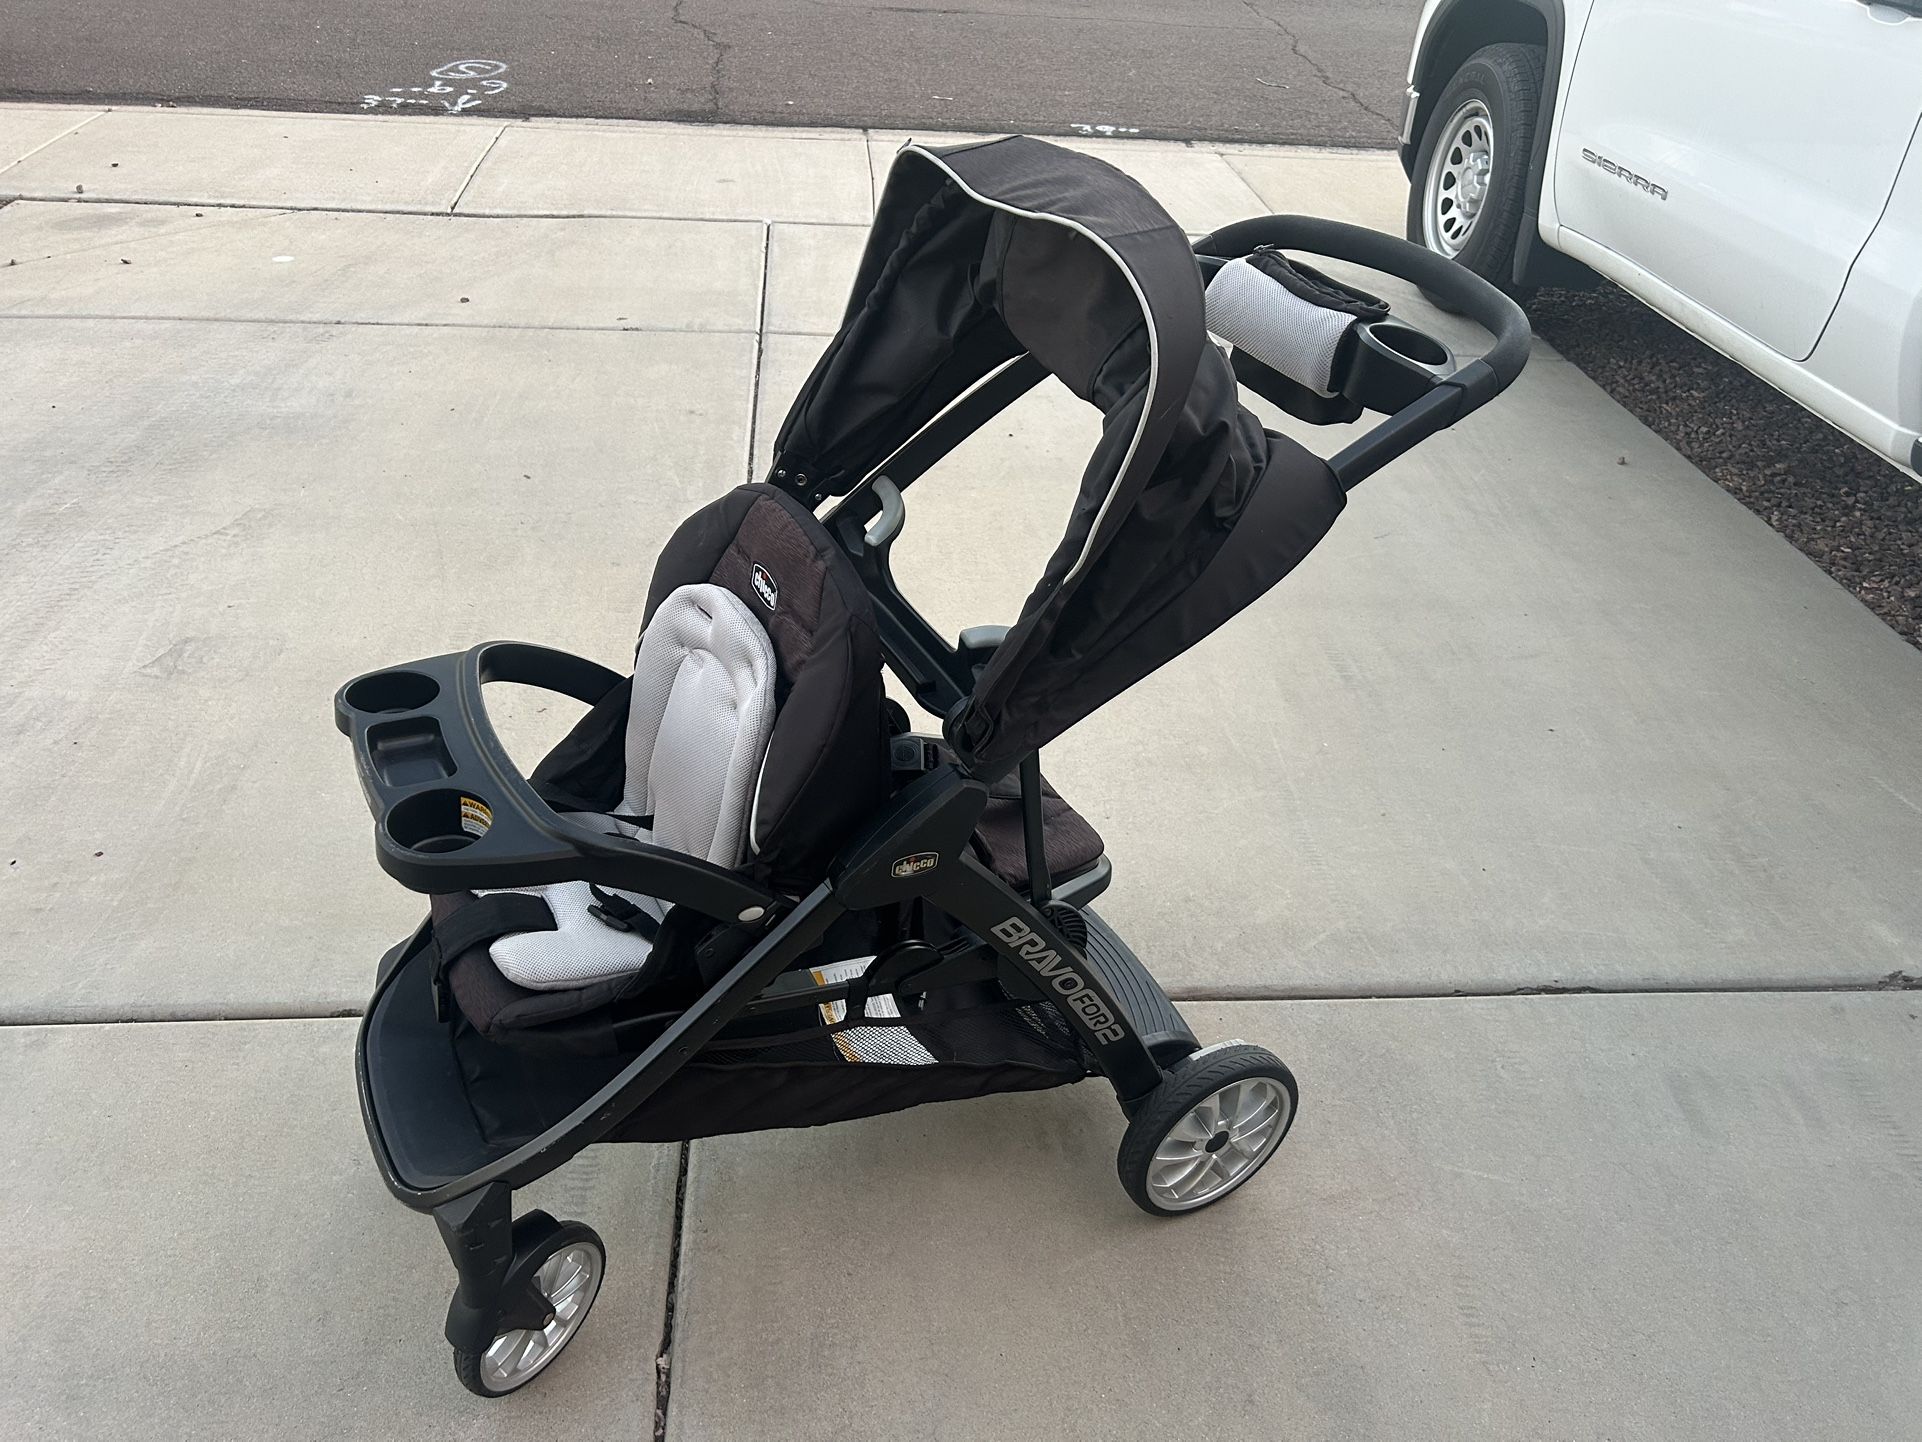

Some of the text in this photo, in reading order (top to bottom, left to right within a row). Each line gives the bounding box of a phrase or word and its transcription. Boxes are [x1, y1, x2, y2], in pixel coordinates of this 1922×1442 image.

[1581, 147, 1668, 201] SIERRA
[754, 570, 775, 607] chicco
[895, 858, 935, 876] chicco
